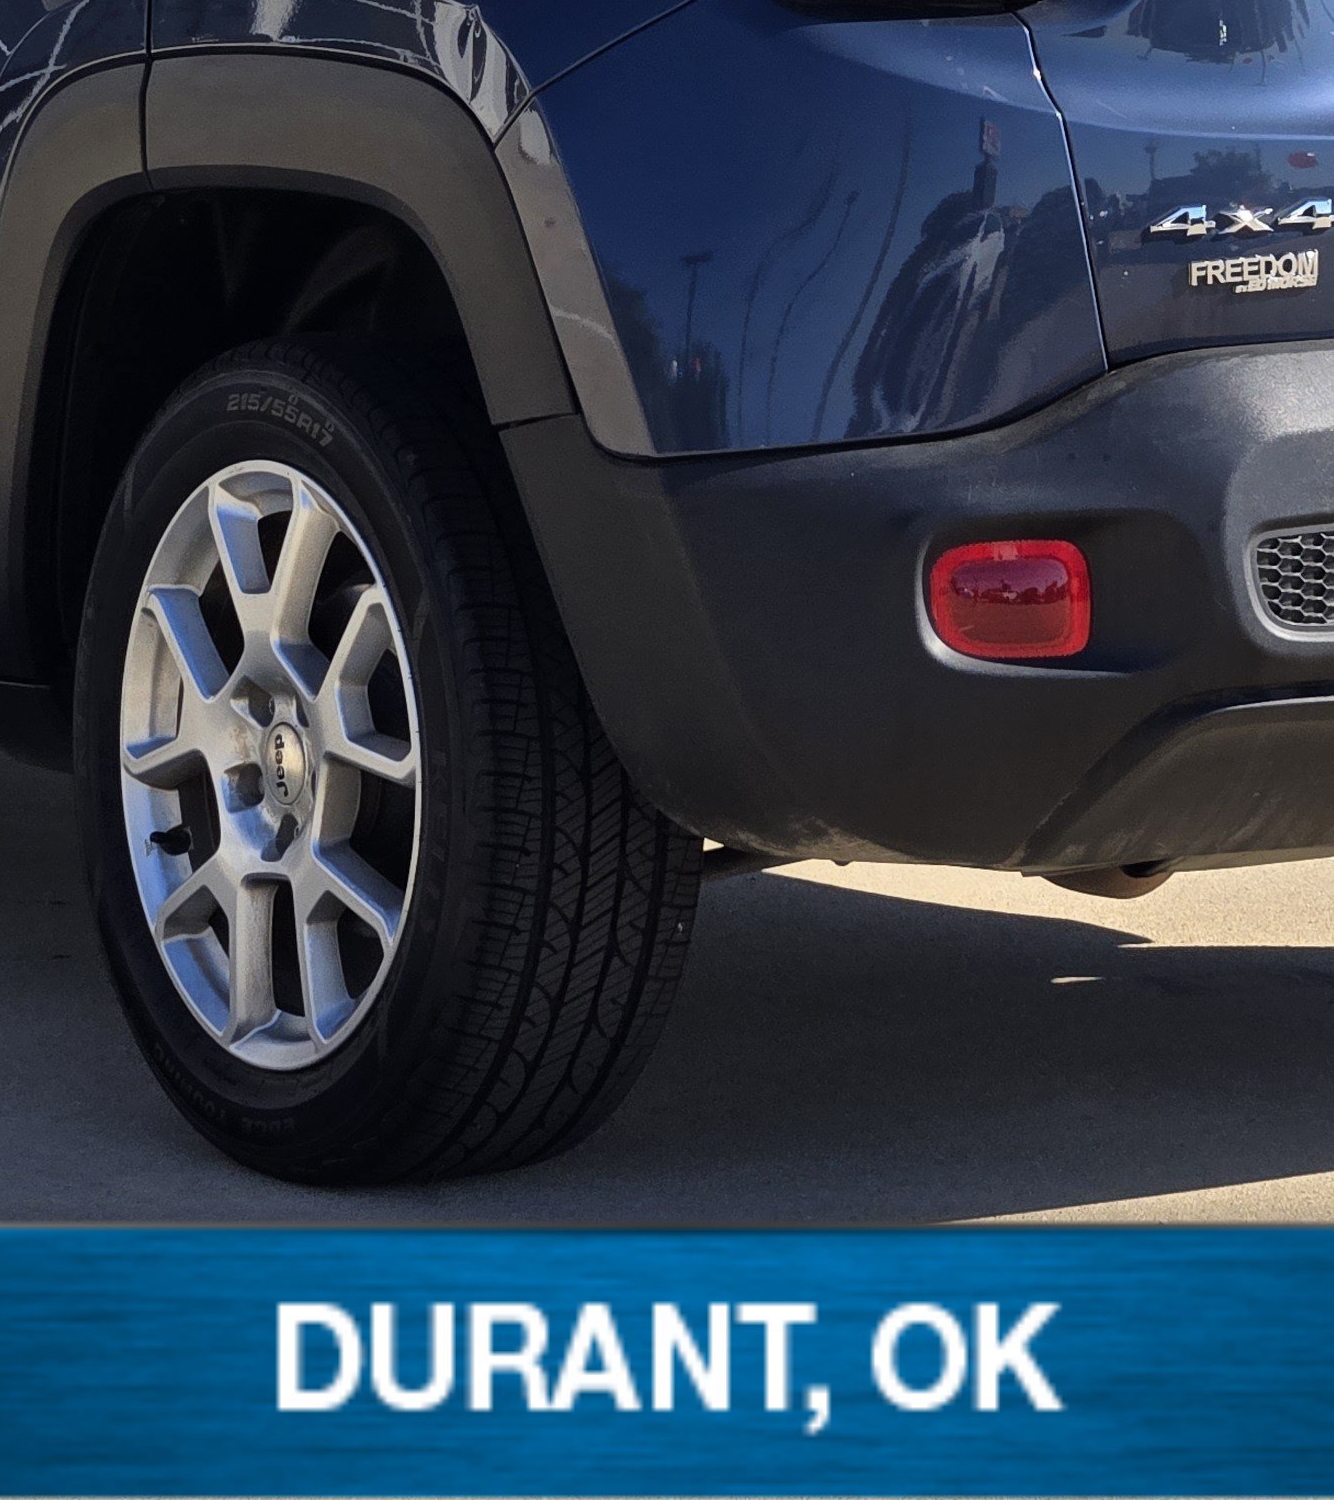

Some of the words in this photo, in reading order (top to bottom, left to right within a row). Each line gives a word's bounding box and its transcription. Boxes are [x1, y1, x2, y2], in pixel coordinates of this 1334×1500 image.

[1189, 249, 1318, 286] FREEDOM
[226, 392, 334, 448] 215/55R17
[274, 733, 289, 798] Jeep
